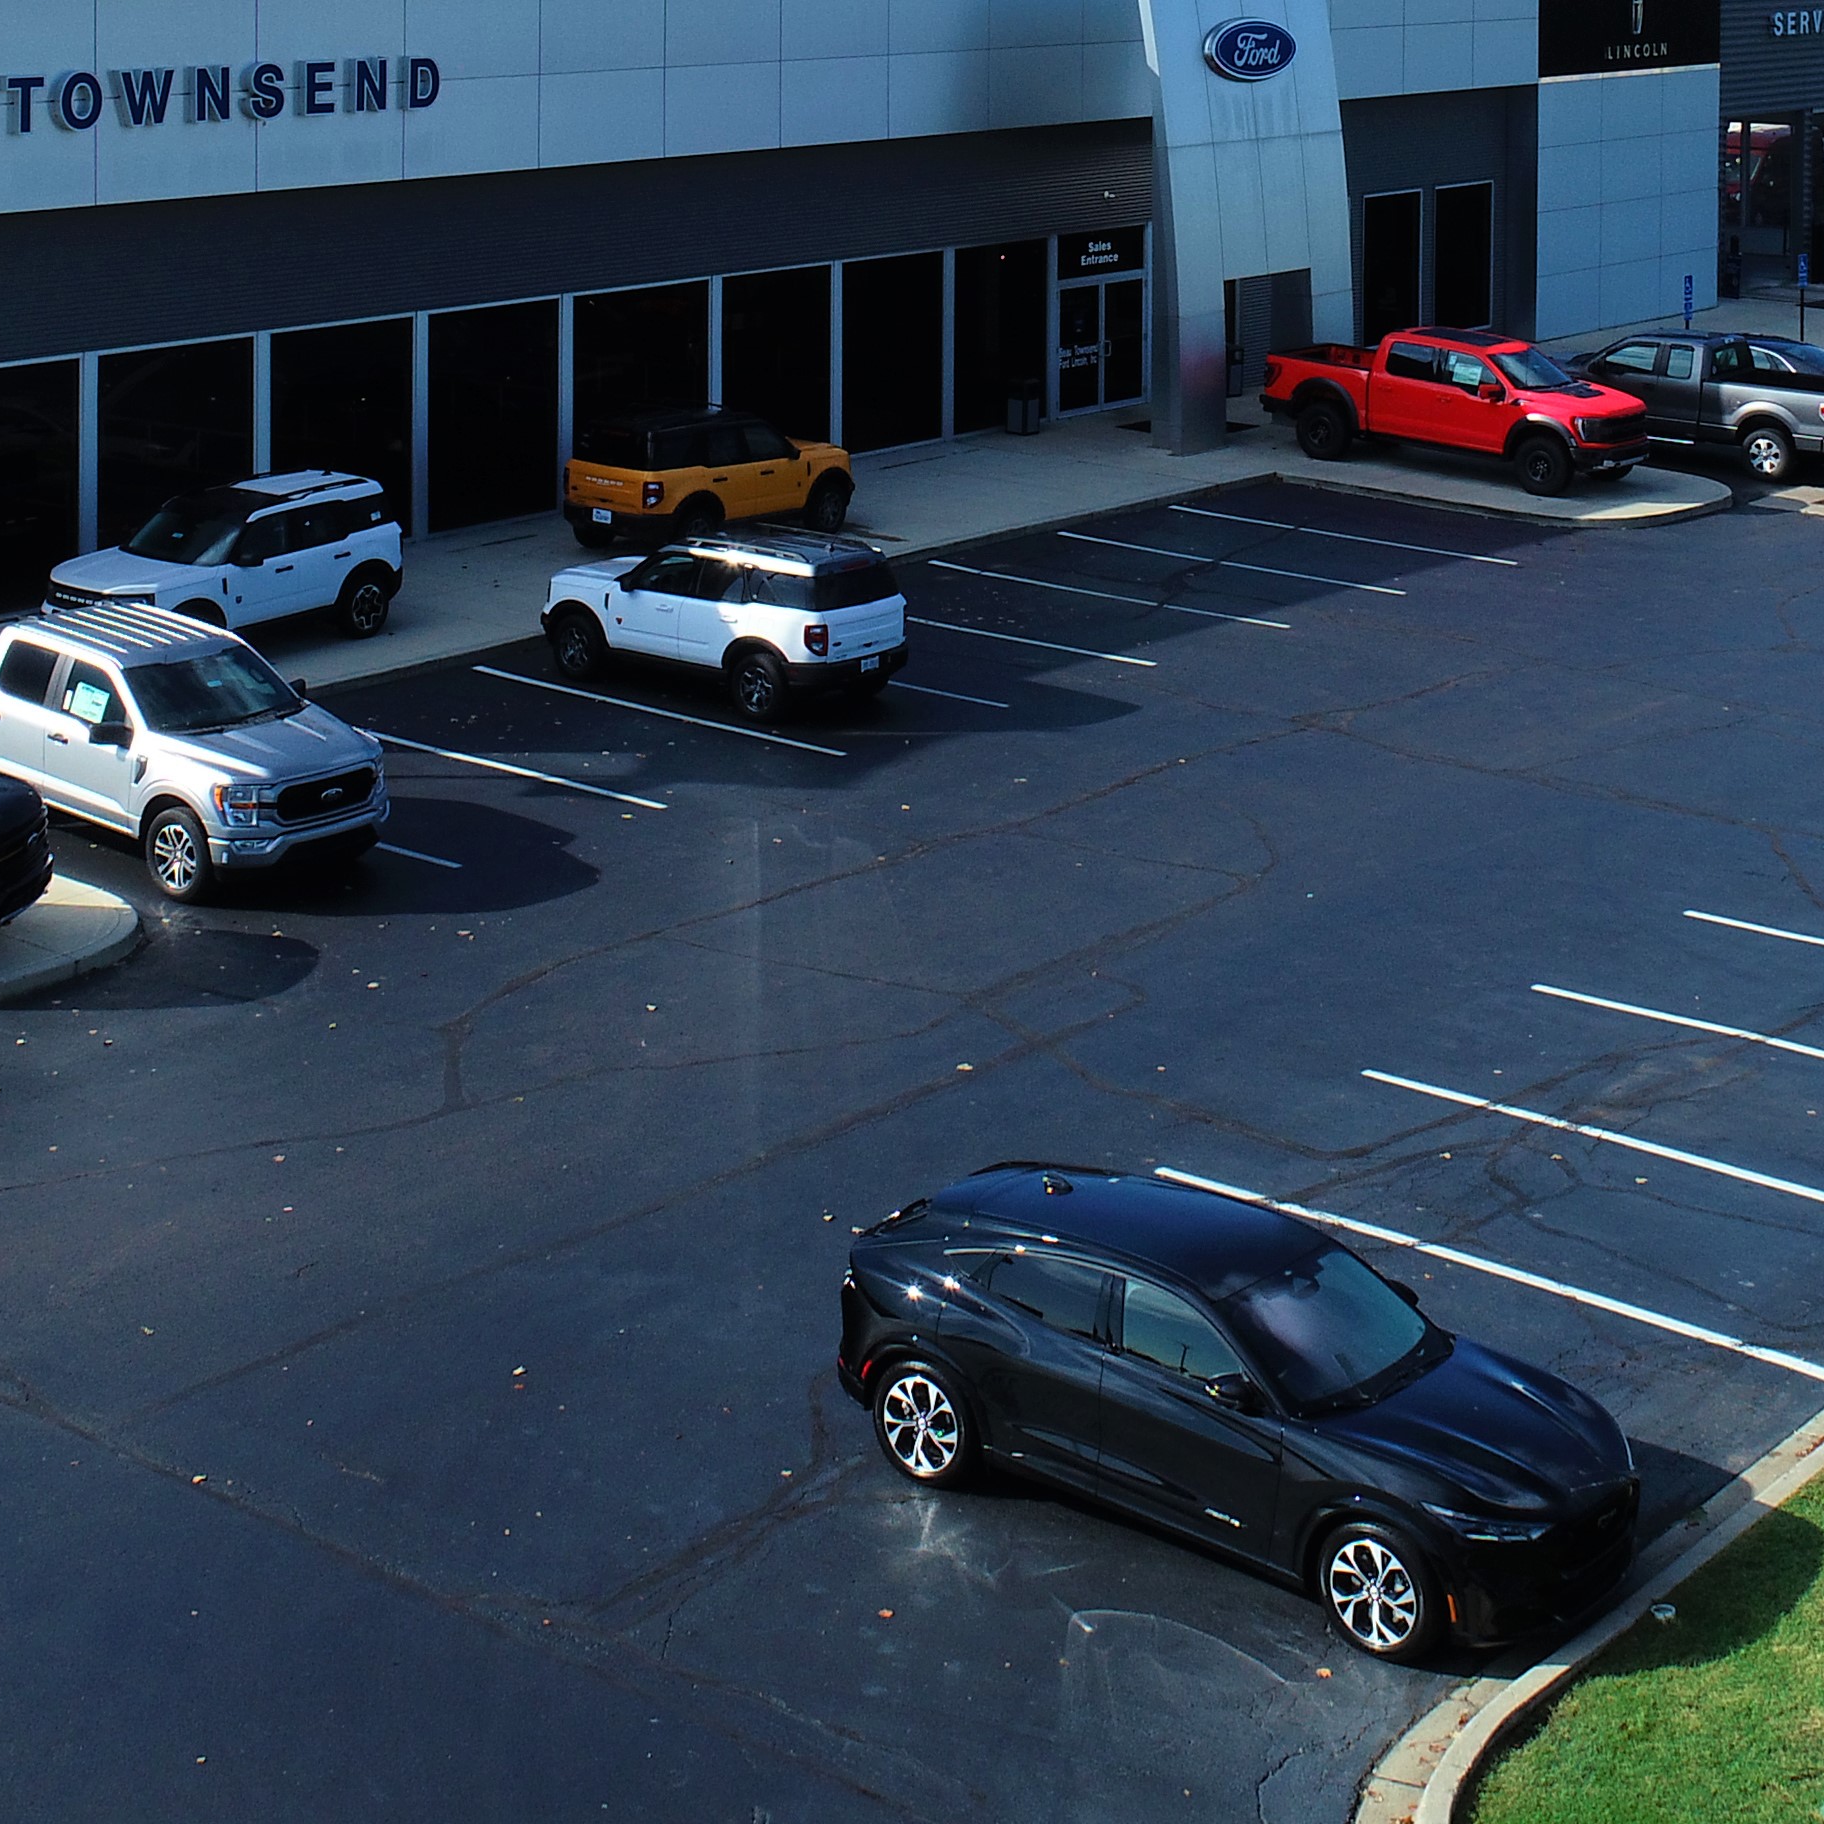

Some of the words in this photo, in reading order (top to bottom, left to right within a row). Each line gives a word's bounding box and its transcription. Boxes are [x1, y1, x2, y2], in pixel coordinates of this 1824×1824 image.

[1234, 32, 1281, 67] Ford
[1606, 42, 1668, 60] LINCOLN
[5, 56, 443, 134] TOWNSEND
[1088, 241, 1112, 253] Sales
[1081, 253, 1119, 266] Entrance
